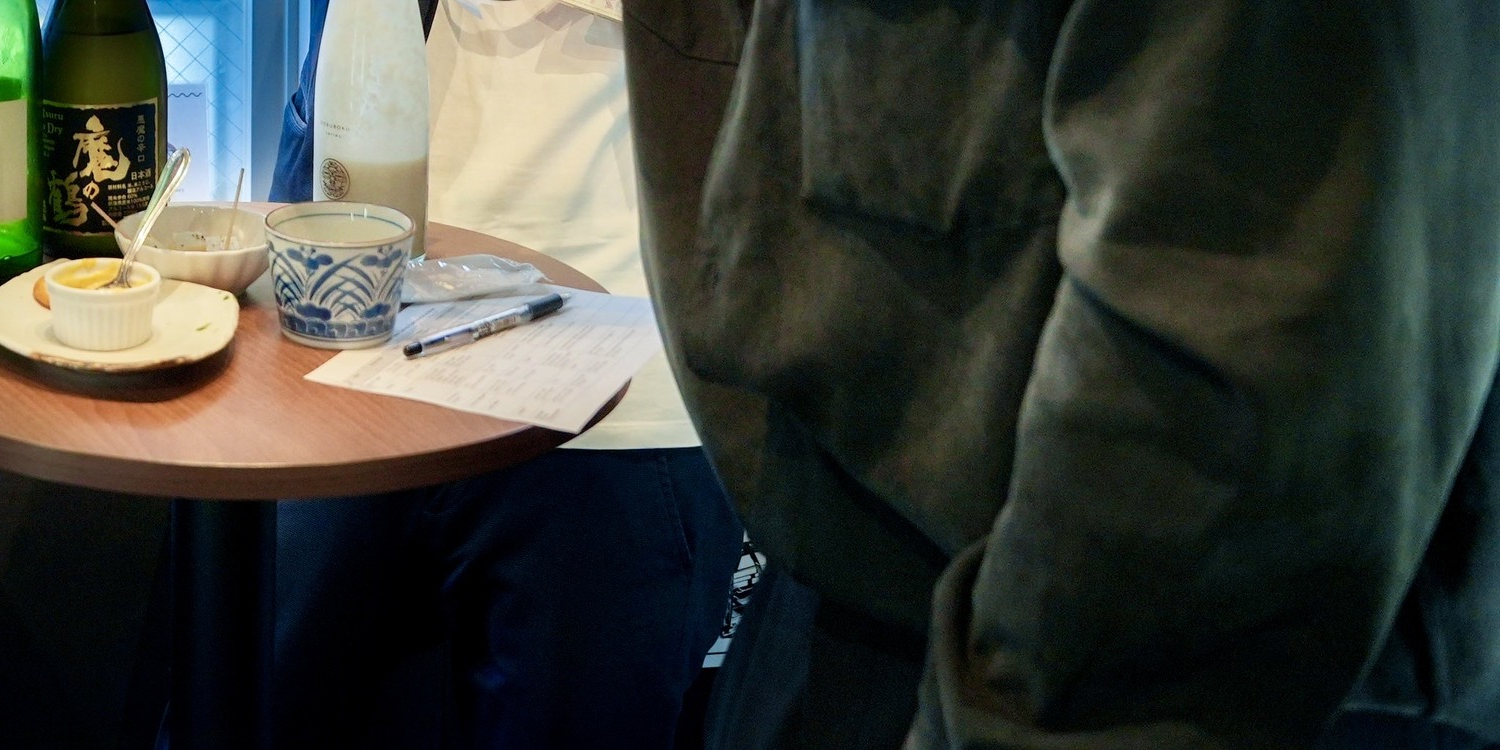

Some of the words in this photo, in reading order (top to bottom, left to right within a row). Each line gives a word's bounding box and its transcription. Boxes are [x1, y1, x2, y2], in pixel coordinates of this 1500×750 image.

[47, 122, 64, 136] Dry
[131, 168, 152, 180] 日本酒
